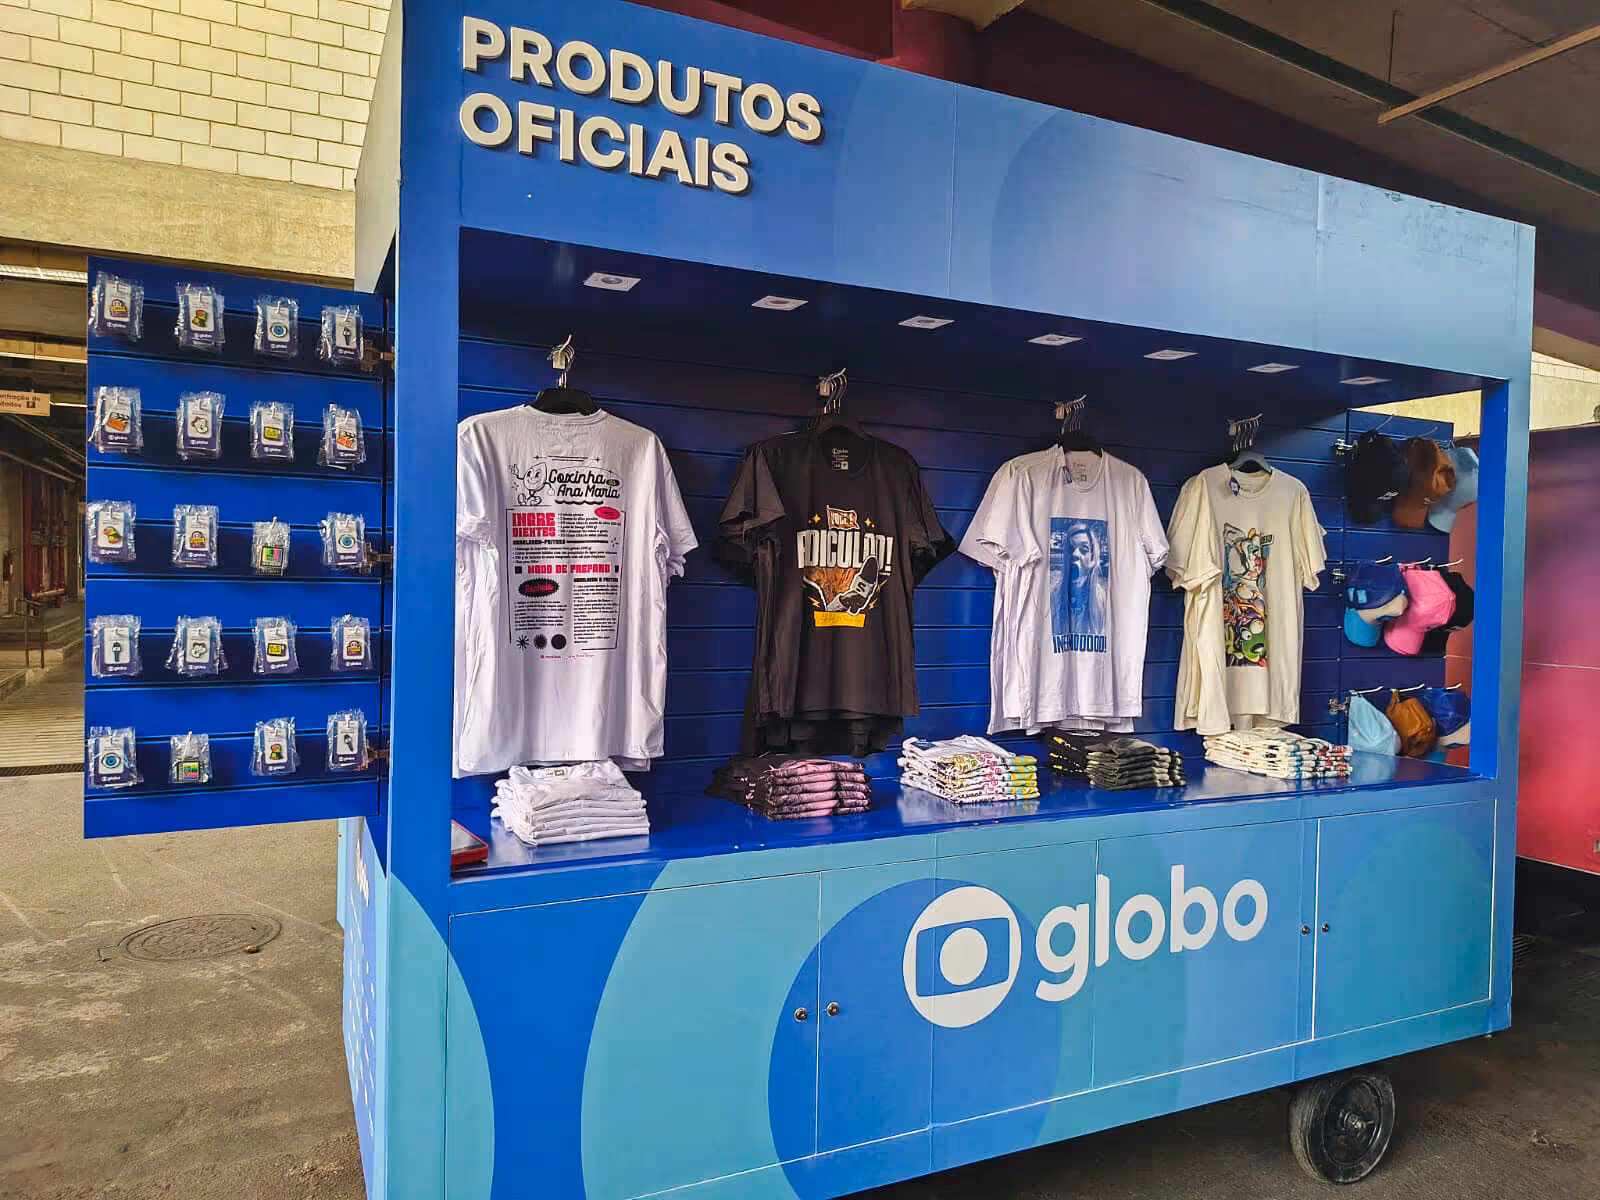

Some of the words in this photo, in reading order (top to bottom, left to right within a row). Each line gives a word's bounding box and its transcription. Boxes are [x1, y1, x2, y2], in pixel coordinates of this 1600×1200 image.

[463, 16, 822, 142] PRODUTOS
[459, 92, 749, 194] OFICIAIS
[548, 469, 606, 484] Coxinha
[557, 484, 583, 497] Ana
[585, 485, 620, 498] Maria
[1035, 864, 1268, 1002] globo
